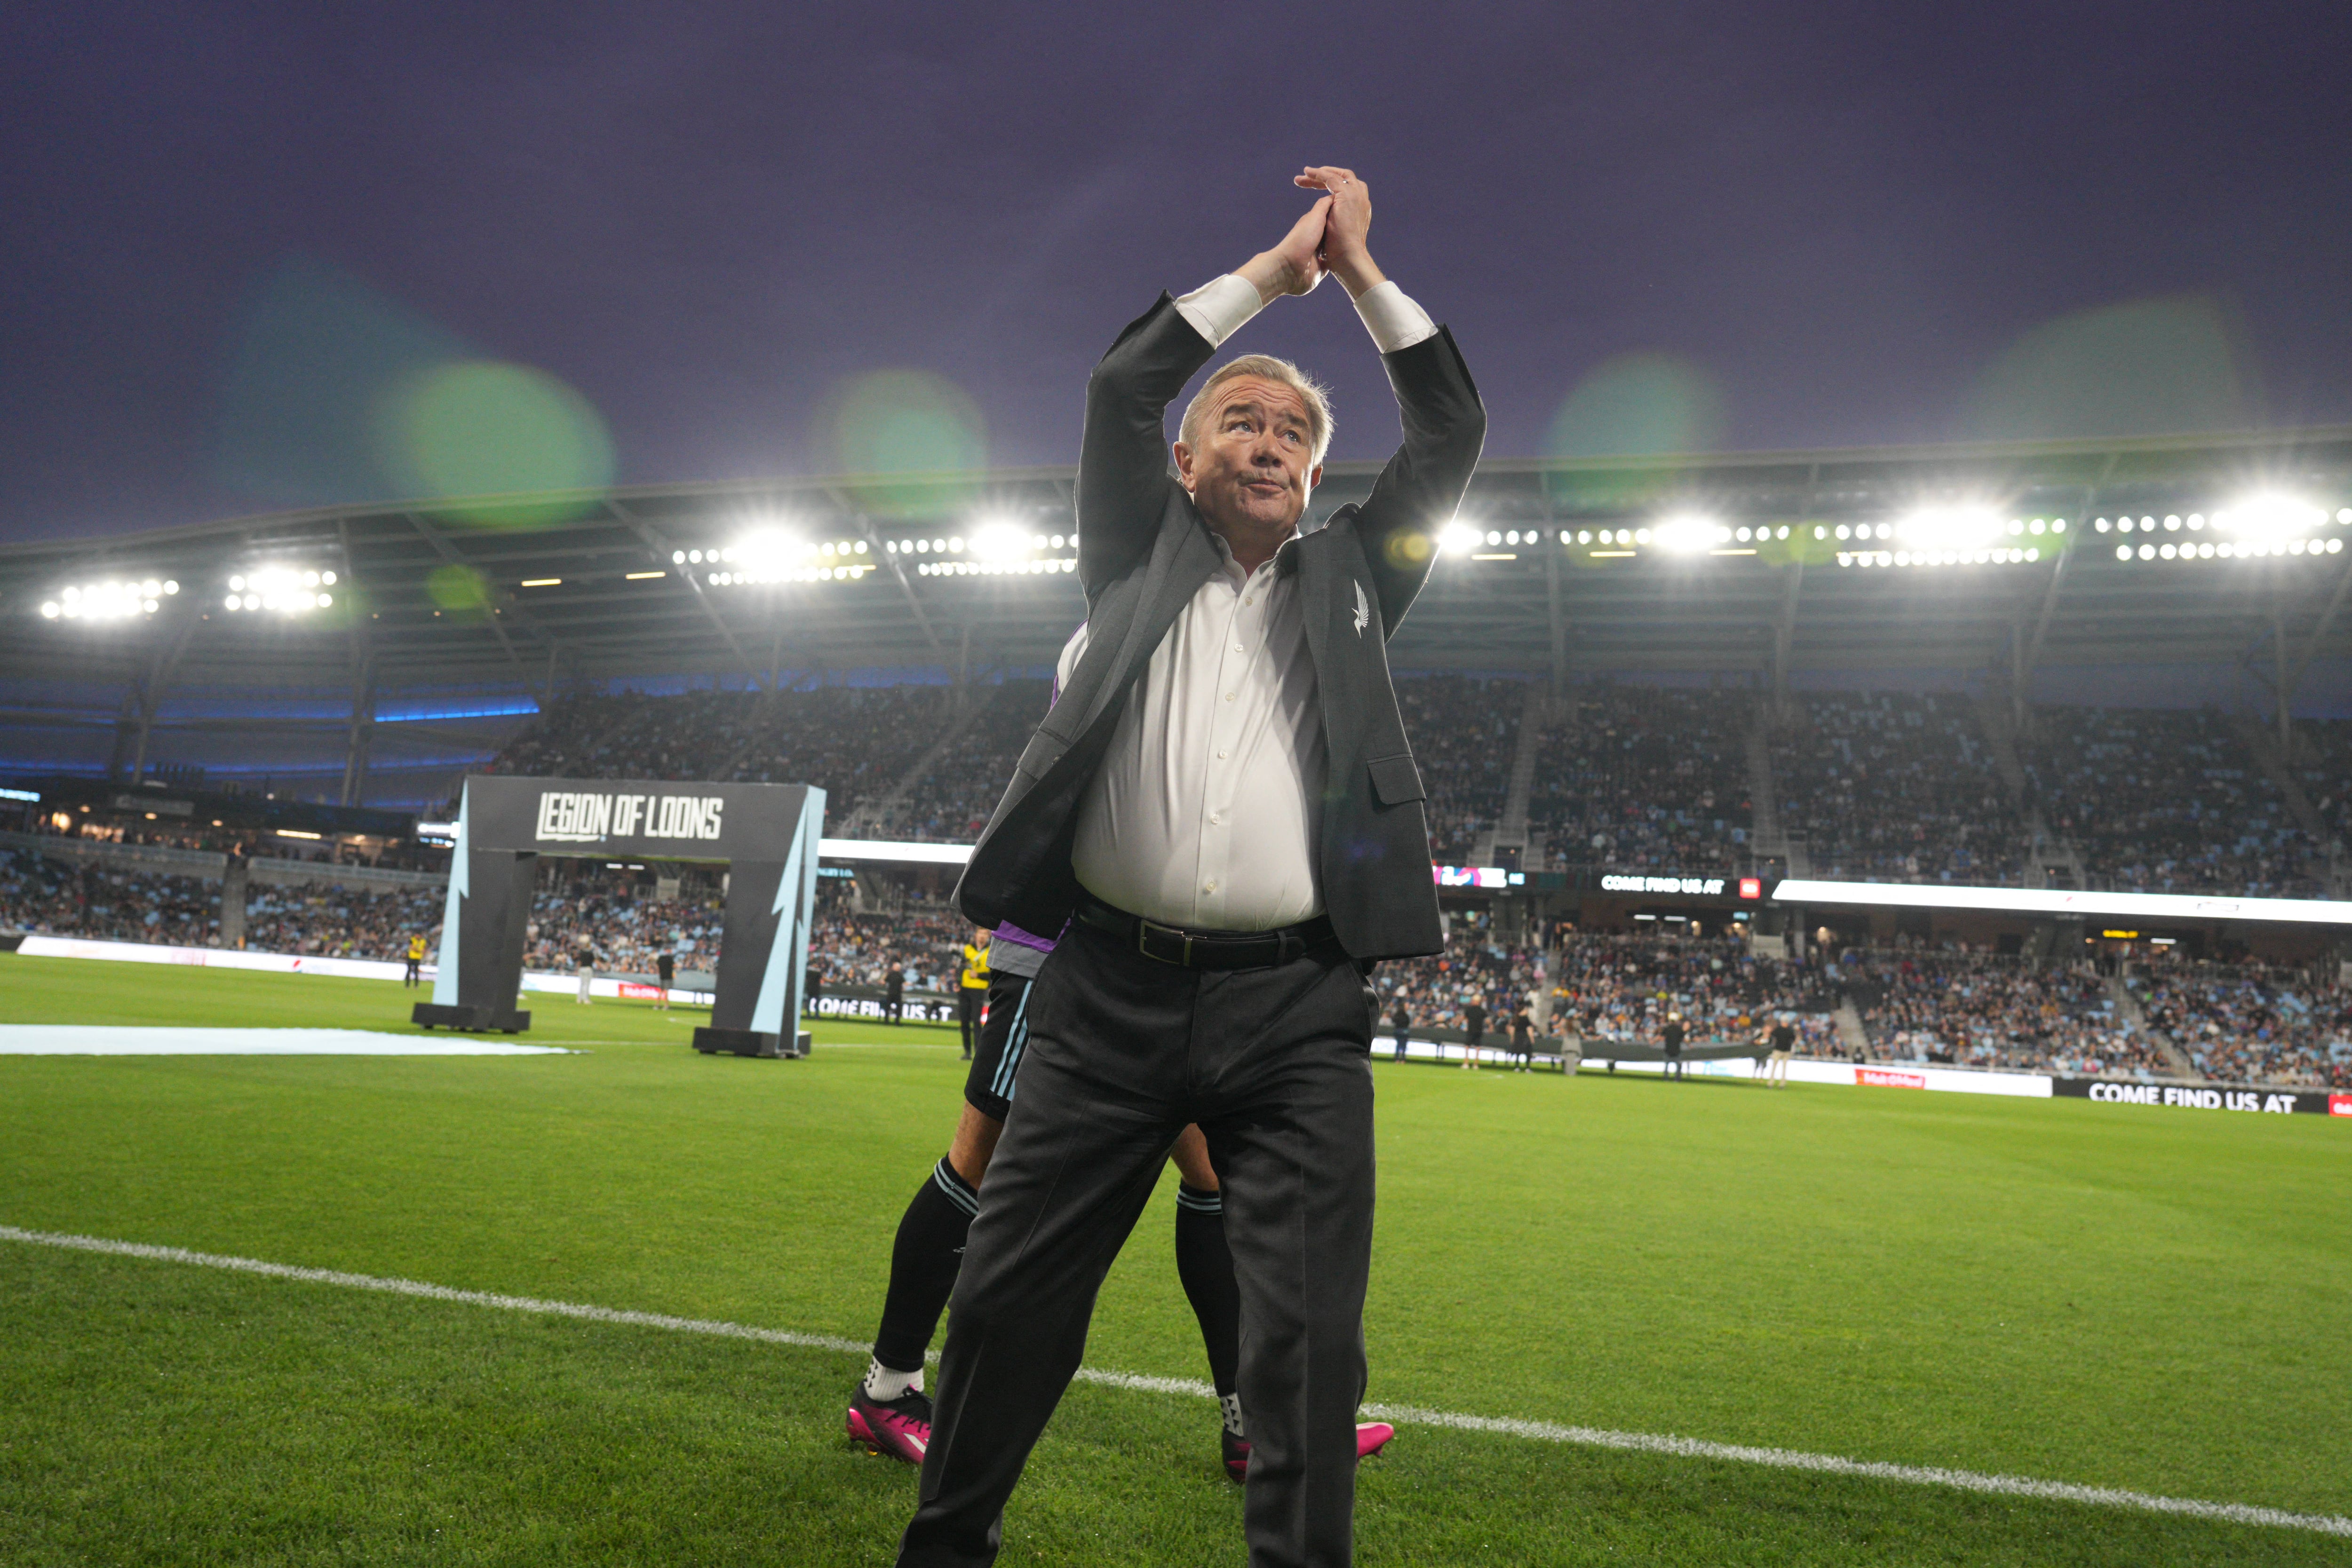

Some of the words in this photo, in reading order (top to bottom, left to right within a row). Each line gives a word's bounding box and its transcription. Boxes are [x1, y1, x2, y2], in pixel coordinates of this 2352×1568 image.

[535, 792, 612, 842] LEGION
[612, 795, 645, 836] OF
[644, 795, 724, 839] LOONS
[1601, 875, 1645, 891] COME
[1646, 877, 1681, 893] FIND
[1681, 879, 1704, 894] US
[1703, 879, 1725, 895] AT
[902, 1004, 926, 1020] US
[2089, 1083, 2160, 1105] COME
[2164, 1088, 2222, 1109] FIND
[2226, 1092, 2259, 1112] US
[2264, 1094, 2297, 1114] AT
